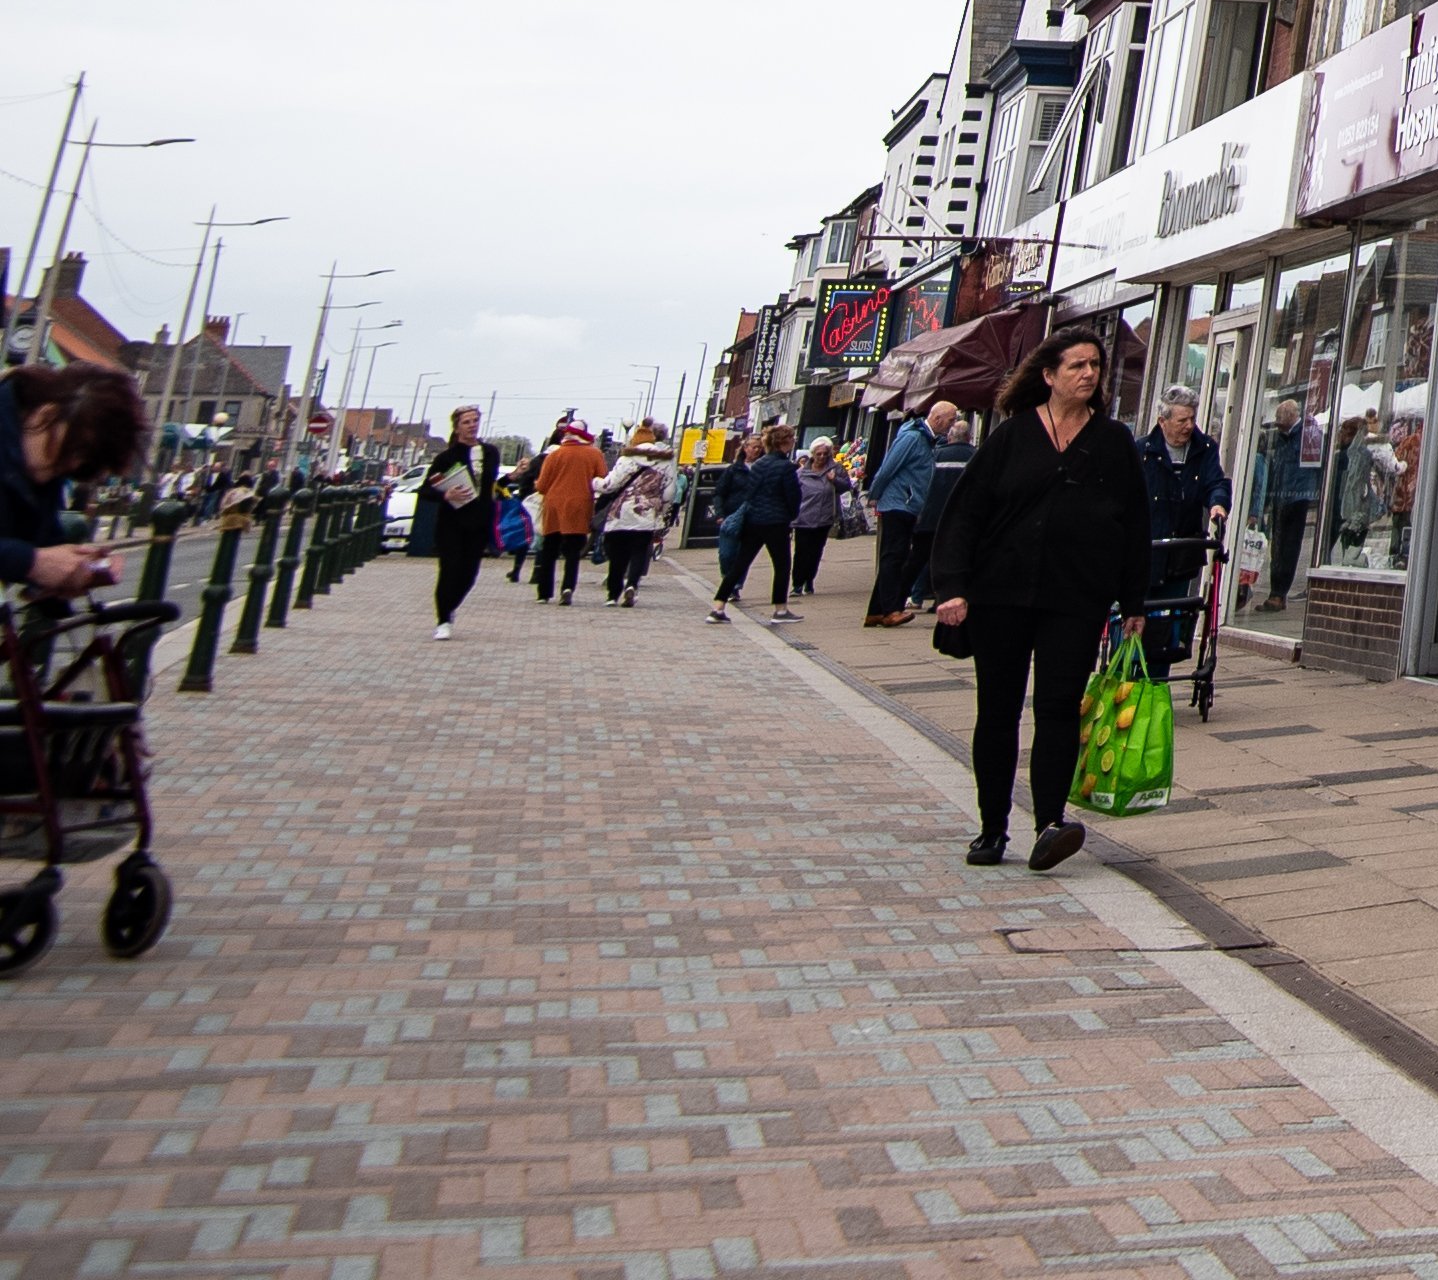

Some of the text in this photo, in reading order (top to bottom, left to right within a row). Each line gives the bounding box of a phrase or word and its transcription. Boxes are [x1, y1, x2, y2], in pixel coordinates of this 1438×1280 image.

[754, 309, 772, 384] RESTAURANT
[822, 287, 891, 355] Casino
[849, 340, 873, 352] SLOTS
[763, 324, 779, 385] TAKEAWAY
[1138, 790, 1164, 801] ASDA
